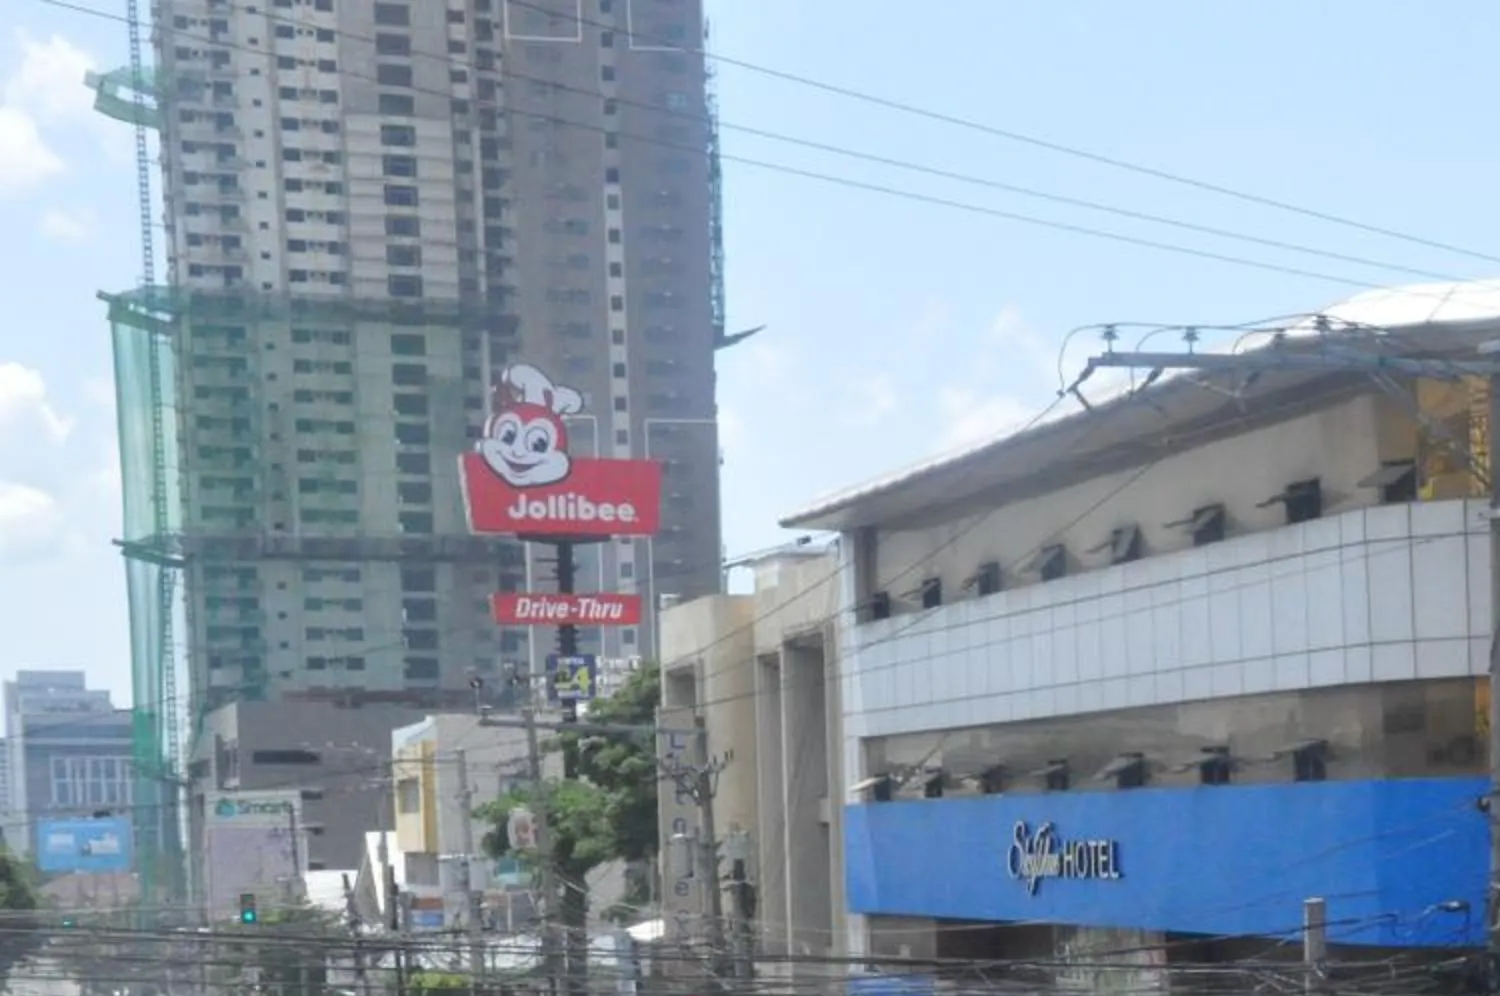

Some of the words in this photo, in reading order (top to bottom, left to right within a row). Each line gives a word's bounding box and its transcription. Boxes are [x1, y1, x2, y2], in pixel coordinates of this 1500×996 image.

[508, 493, 636, 522] Jollibee
[515, 598, 623, 619] Drive-Thru
[1063, 839, 1120, 879] HOTEL
